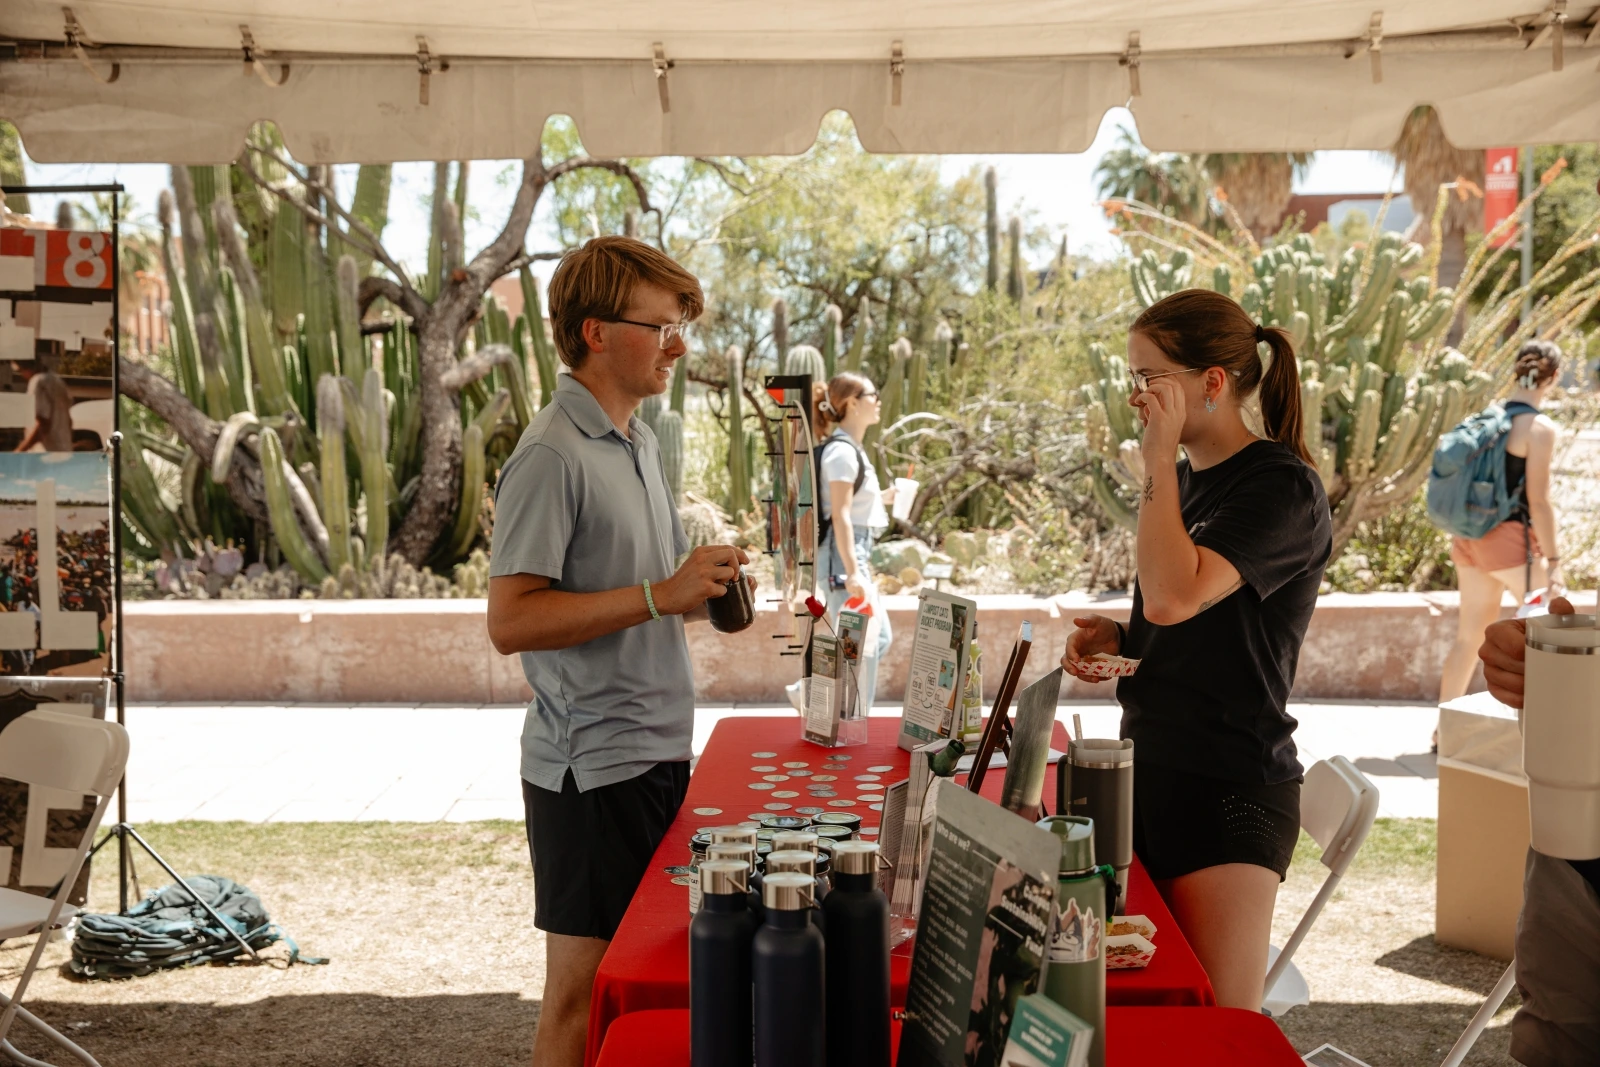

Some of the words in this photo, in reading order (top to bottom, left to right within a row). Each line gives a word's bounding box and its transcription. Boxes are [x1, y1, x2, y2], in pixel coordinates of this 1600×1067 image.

[923, 603, 940, 616] COMPOST
[939, 607, 949, 619] CATS
[920, 616, 934, 628] BUCKET
[934, 618, 952, 632] PROGRAM
[936, 821, 949, 838] Who
[949, 832, 958, 845] are
[958, 838, 971, 852] we?
[1023, 884, 1050, 912] Campus
[1001, 894, 1047, 938] Sustainability
[1025, 935, 1044, 957] Fund
